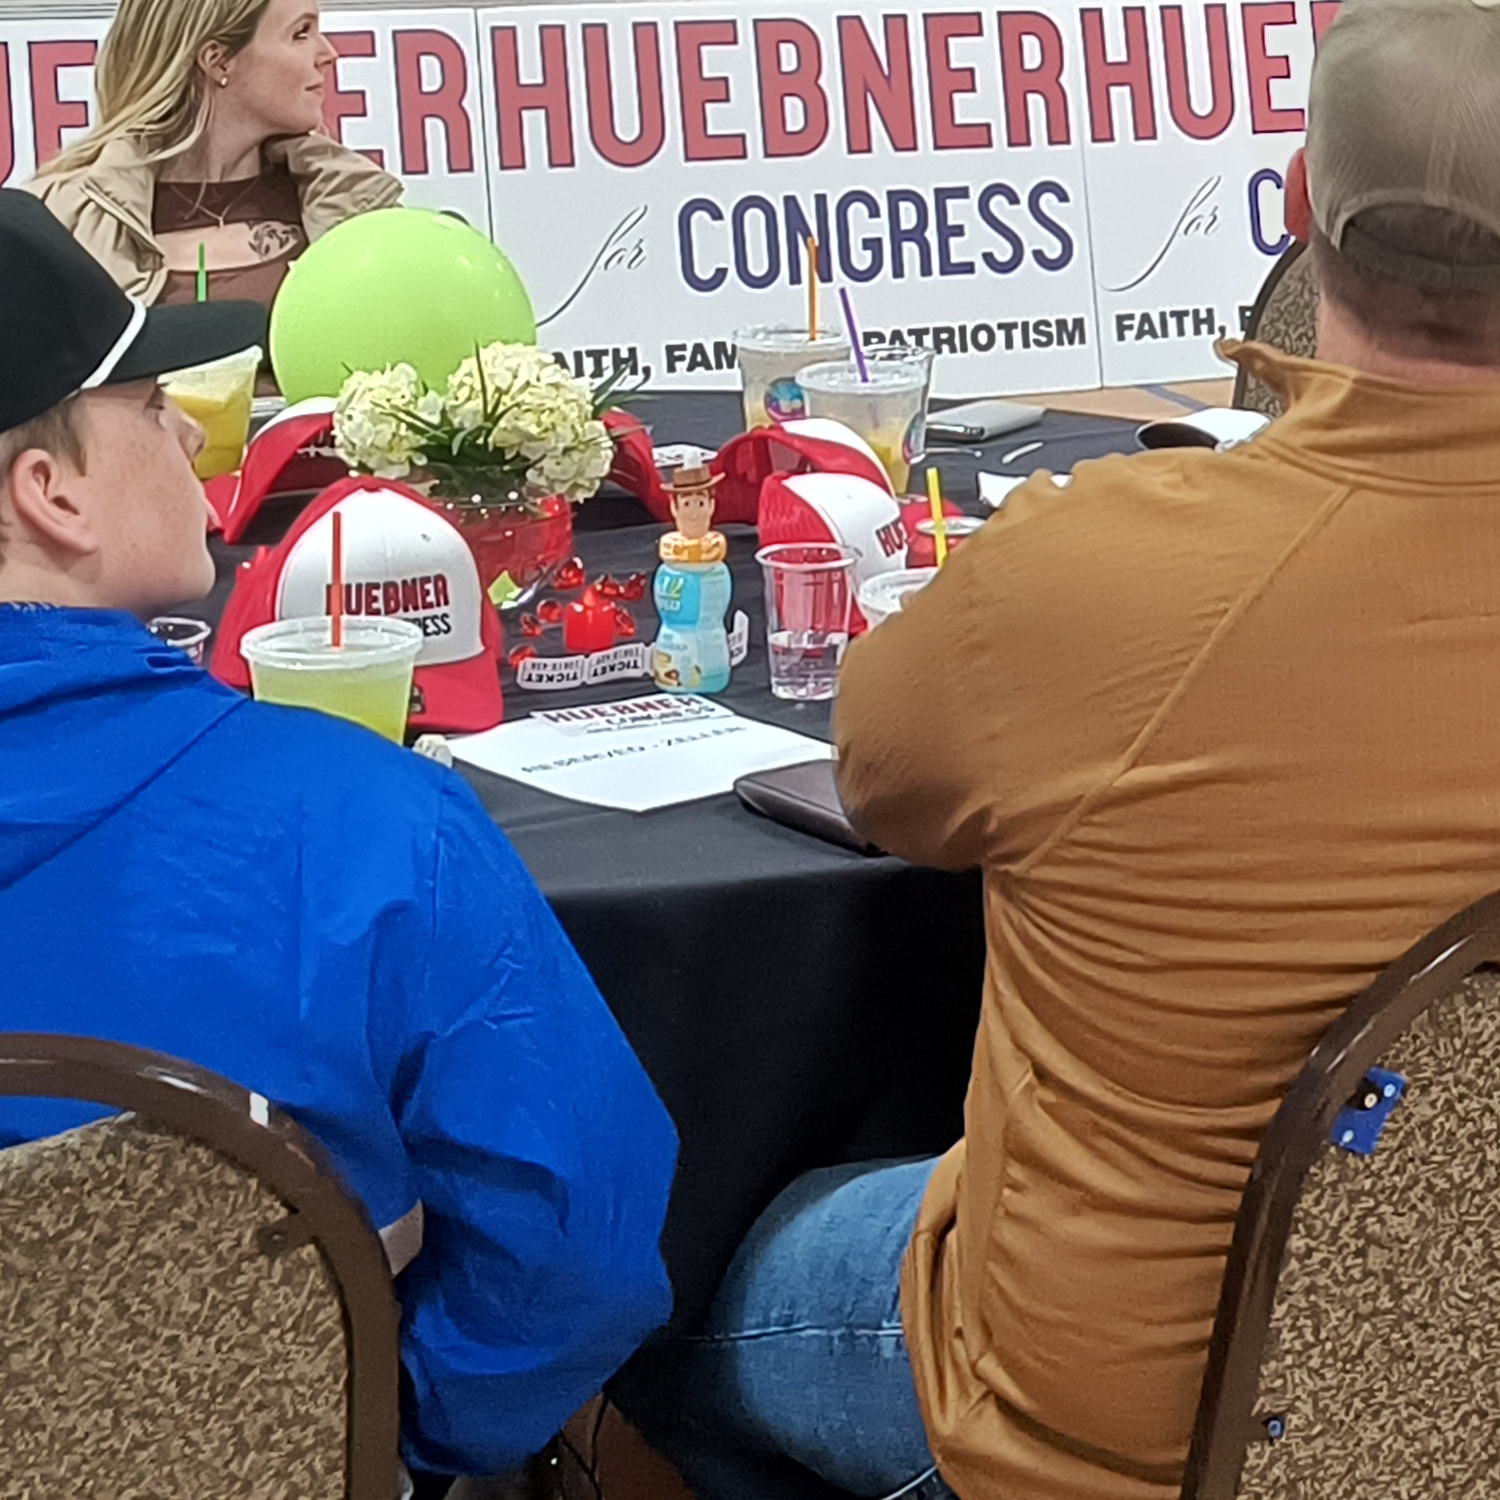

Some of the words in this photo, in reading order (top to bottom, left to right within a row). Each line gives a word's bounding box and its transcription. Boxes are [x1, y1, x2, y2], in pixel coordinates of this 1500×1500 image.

[490, 11, 1071, 170] HUEBNER
[535, 204, 648, 327] for
[678, 180, 1074, 293] CONGRESS
[1101, 176, 1221, 292] for
[1115, 307, 1227, 342] FAITH,
[551, 346, 652, 381] AITH,
[665, 341, 740, 373] FAM
[524, 671, 578, 683] TICKET
[591, 658, 640, 678] TICKET
